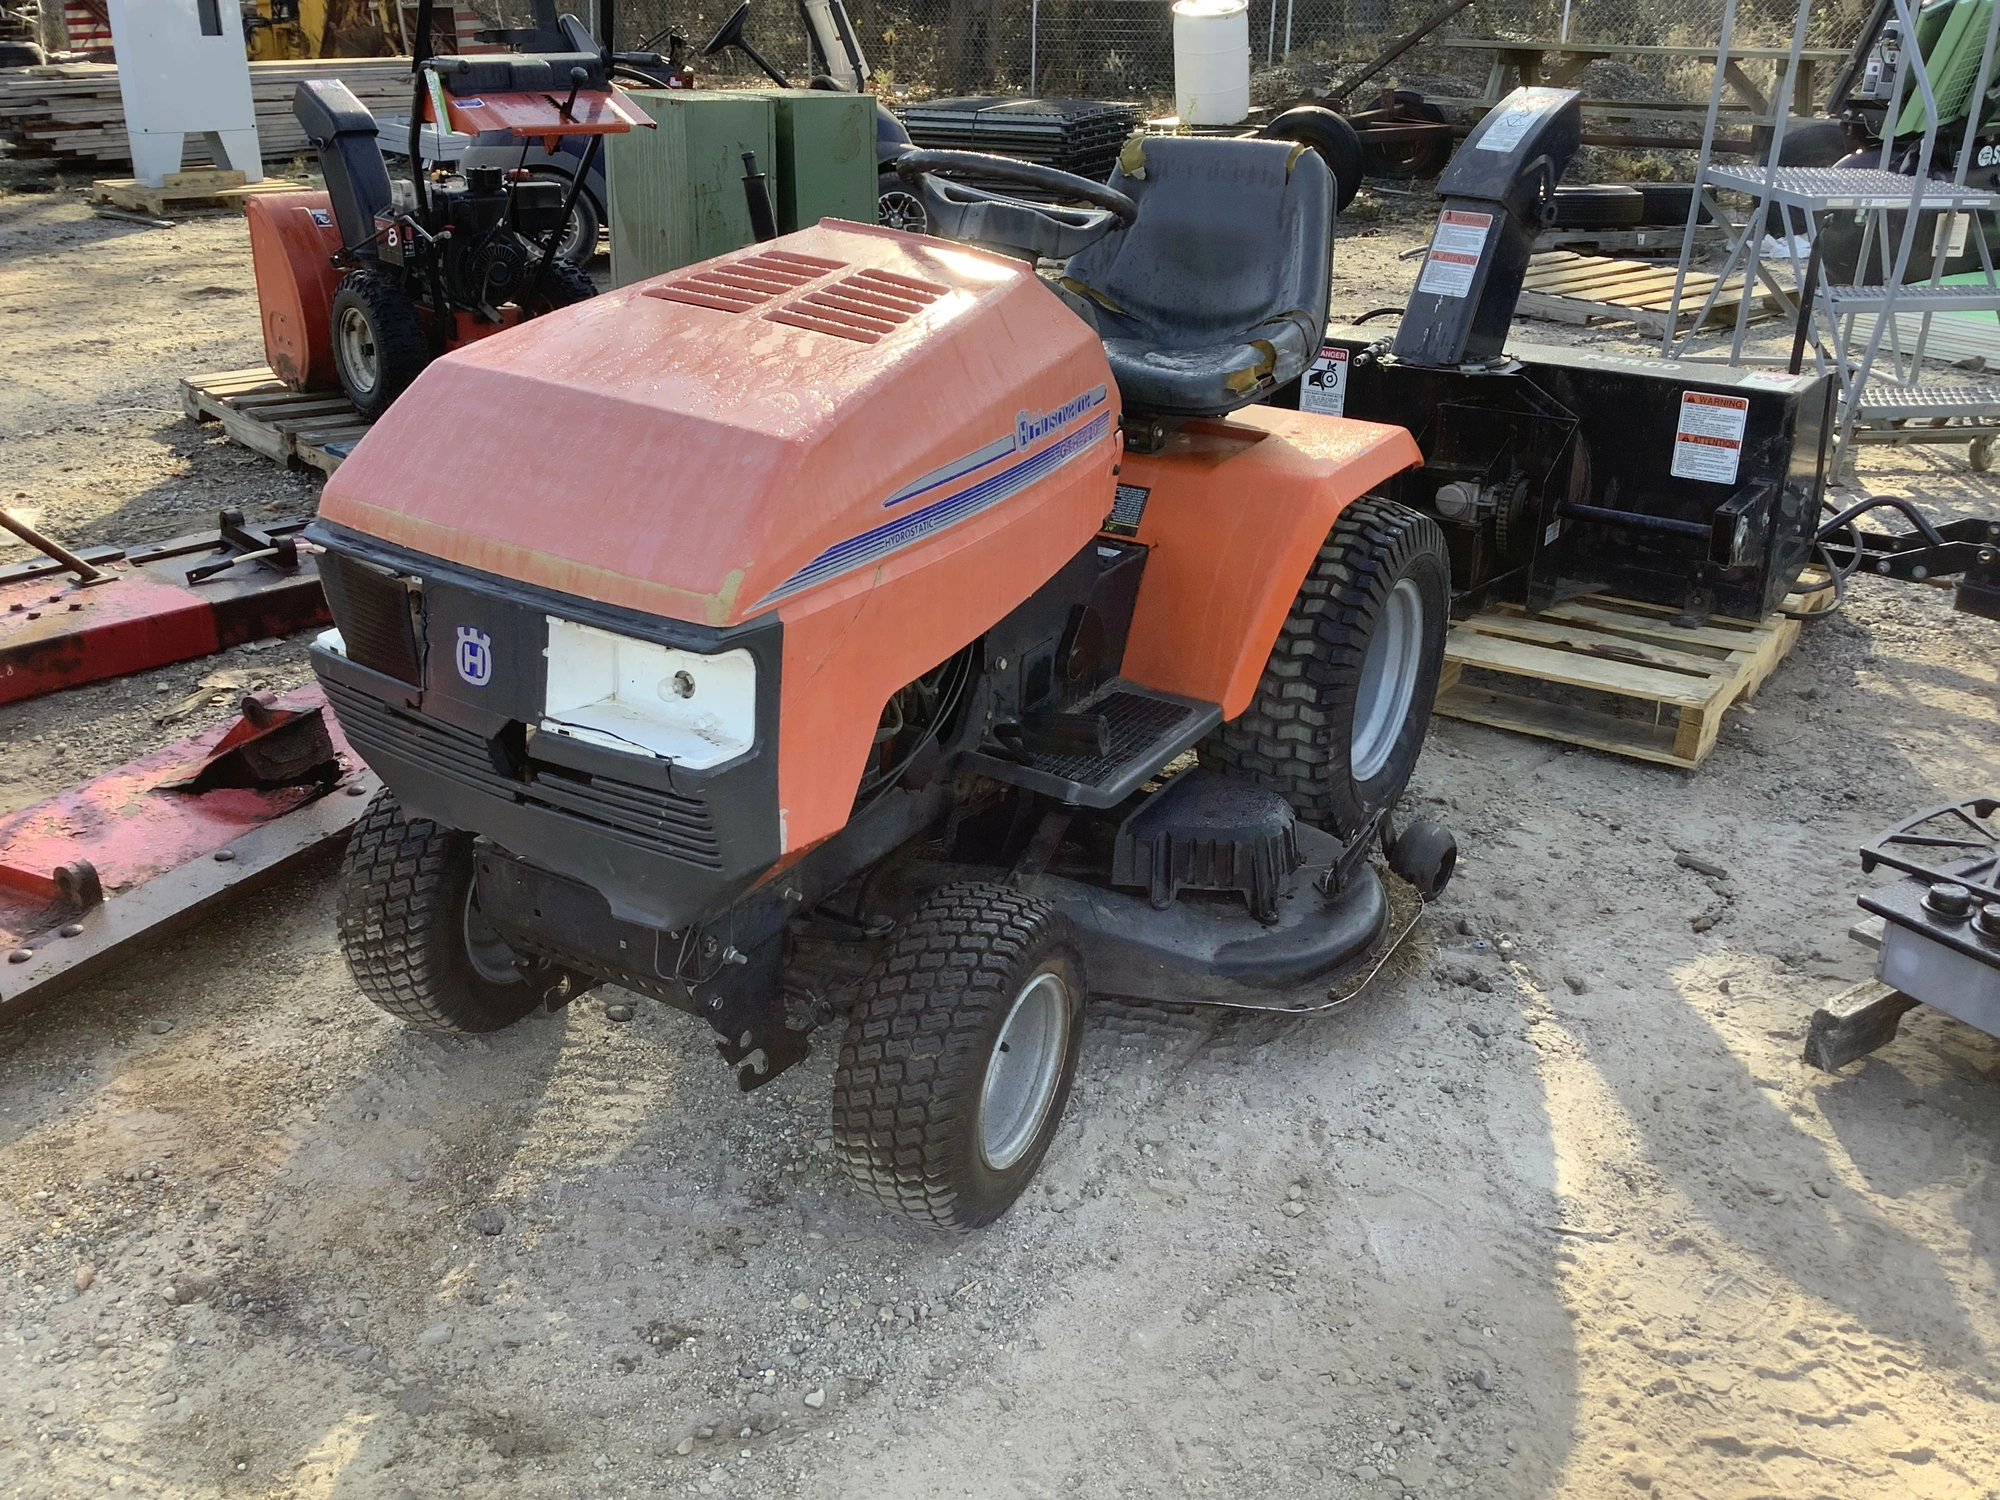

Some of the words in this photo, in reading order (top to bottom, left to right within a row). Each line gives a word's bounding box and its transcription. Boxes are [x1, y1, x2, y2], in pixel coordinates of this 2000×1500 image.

[1454, 215, 1490, 225] WARNING
[387, 228, 398, 247] 8
[1320, 349, 1346, 359] ANGER
[1699, 395, 1743, 408] WARNING
[1029, 394, 1092, 440] Husqvarna
[1690, 436, 1737, 448] ATTENTION
[884, 518, 935, 548] HYDROSTATIC
